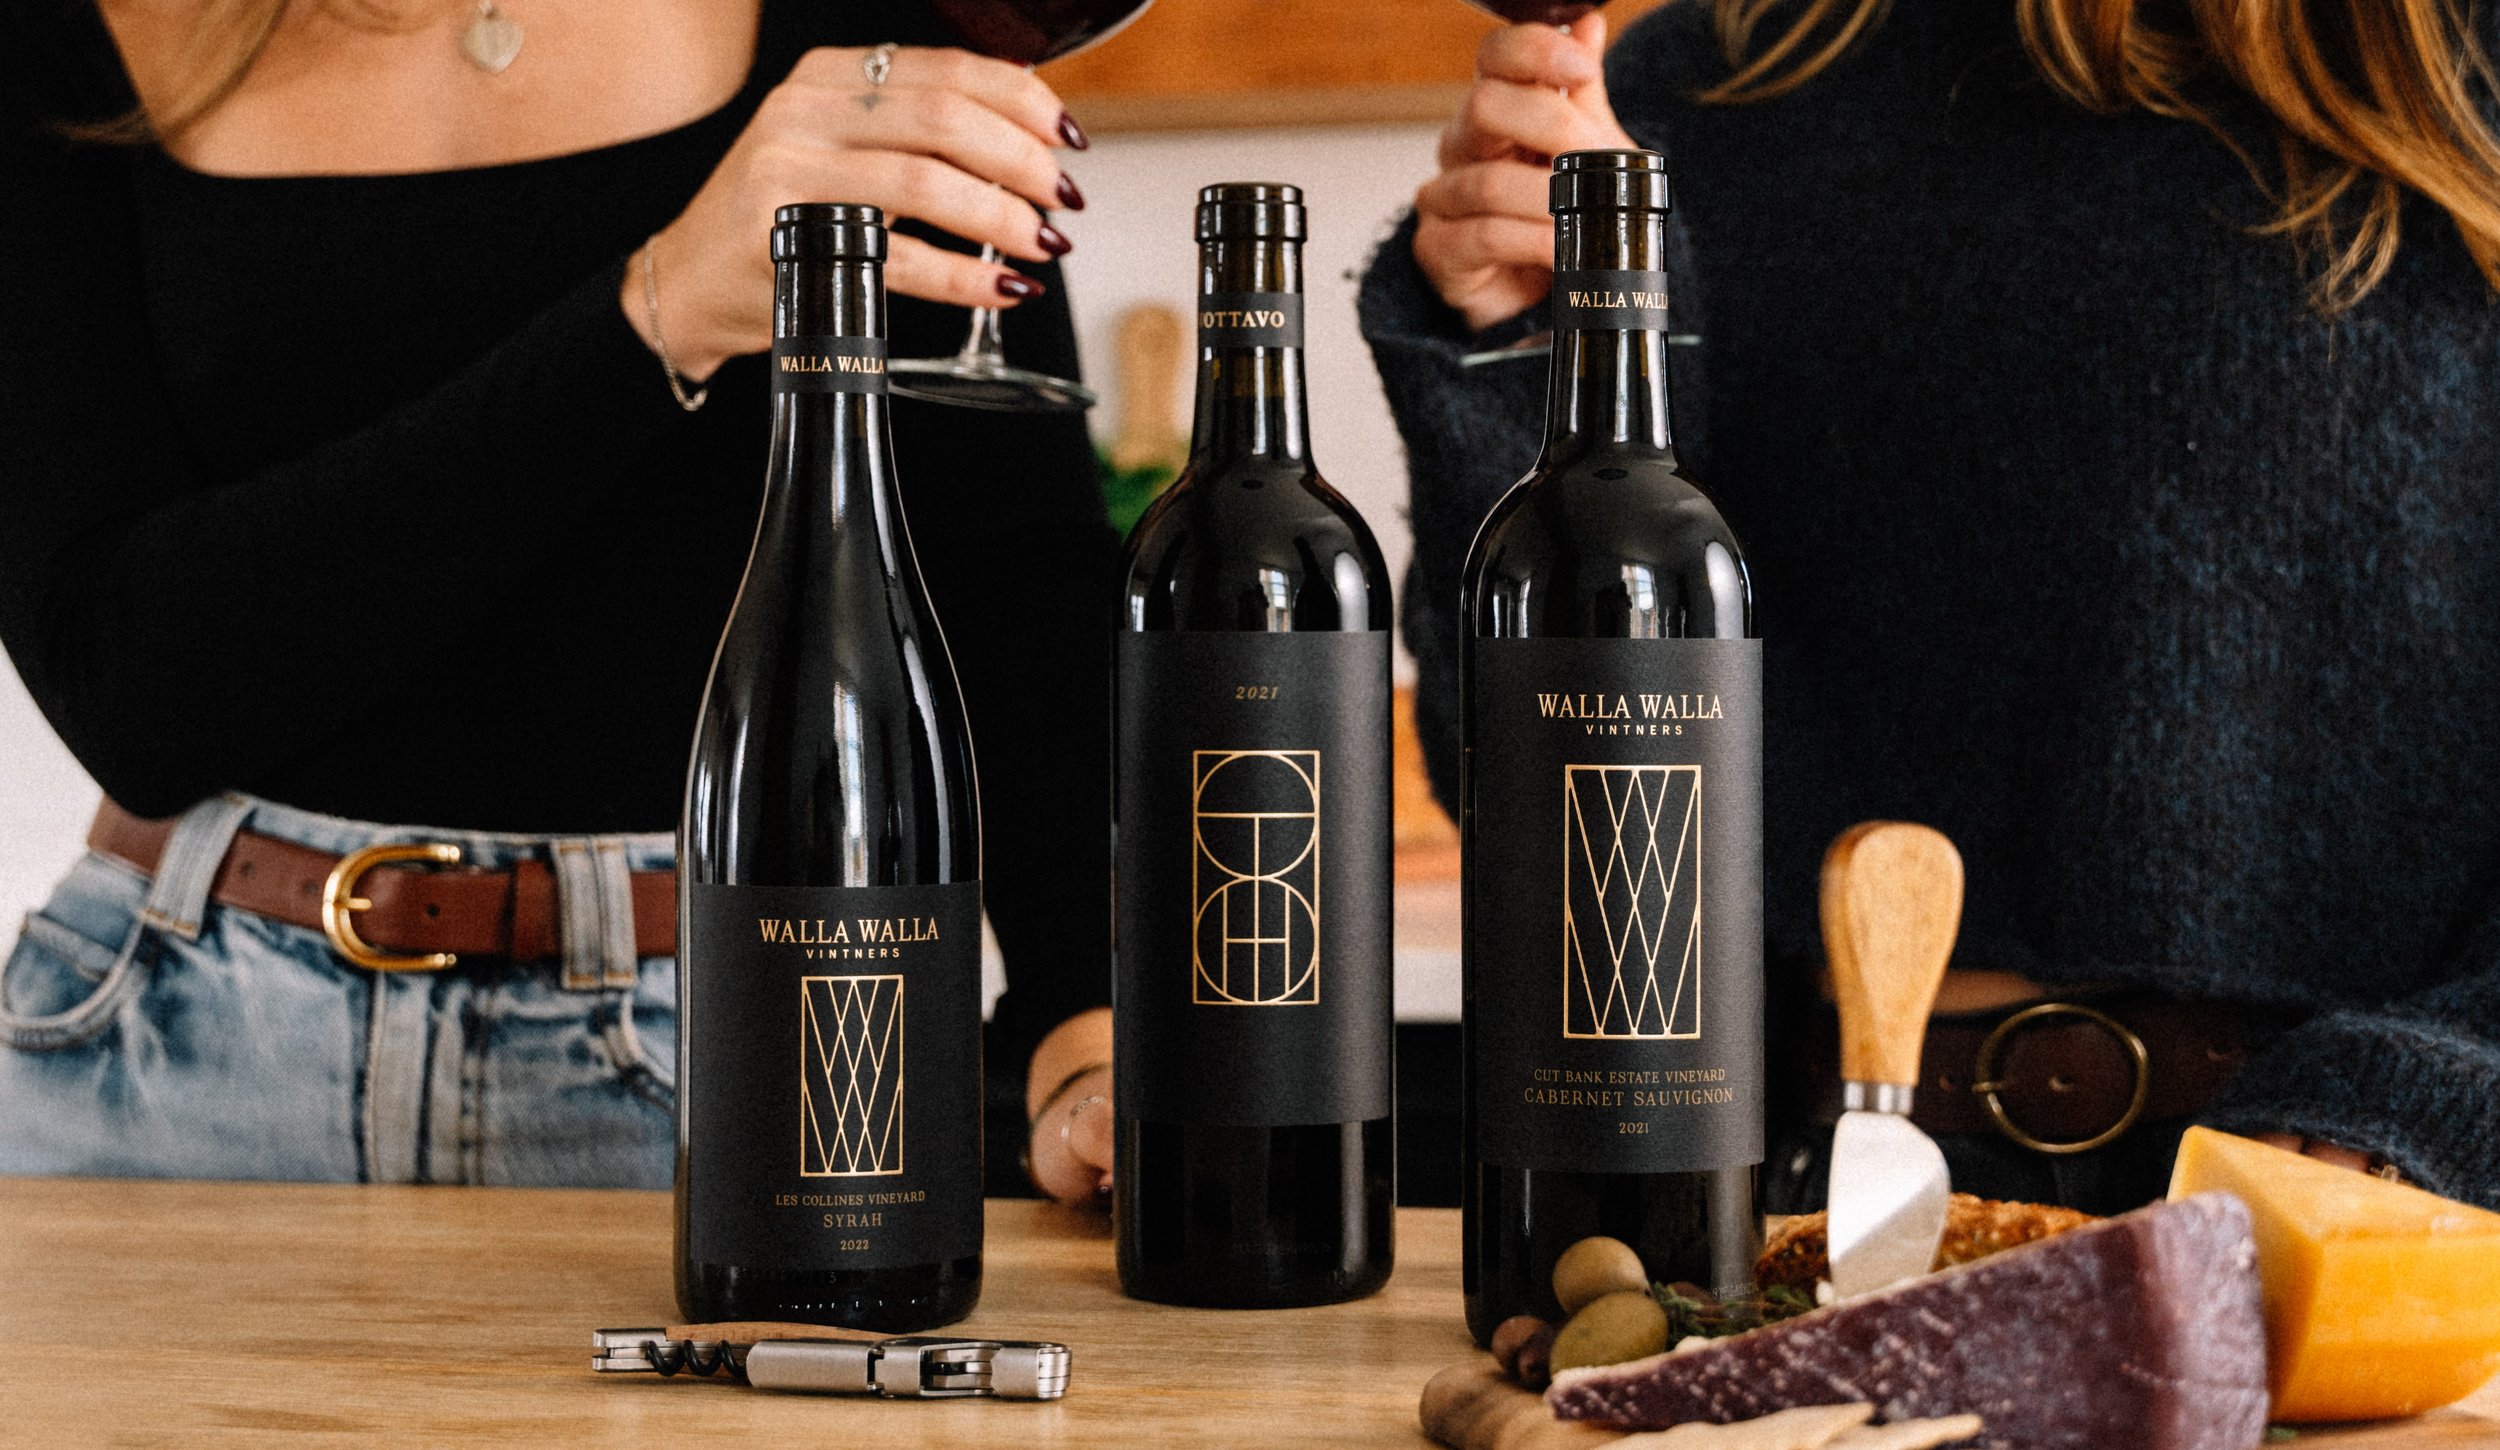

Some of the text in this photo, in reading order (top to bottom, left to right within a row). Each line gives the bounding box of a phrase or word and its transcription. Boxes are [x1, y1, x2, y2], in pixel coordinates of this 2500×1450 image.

[1569, 292, 1627, 308] WALLA
[781, 356, 884, 374] WALLA WALLA
[1235, 686, 1279, 700] 2021
[1537, 694, 1724, 719] WALLA WALLA
[1586, 724, 1683, 736] VINTNERS
[759, 917, 940, 943] WALLA WALLA
[806, 947, 900, 959] VINTNERS
[1534, 1068, 1726, 1084] CUT BANK ESTATE VINEYARD
[1524, 1087, 1733, 1106] CABERNET SAUVIGNON
[1619, 1122, 1650, 1134] 2021
[775, 1190, 926, 1206] LES COLLINES VINEYARD
[823, 1212, 882, 1229] SYRAH
[840, 1239, 870, 1251] 2022
